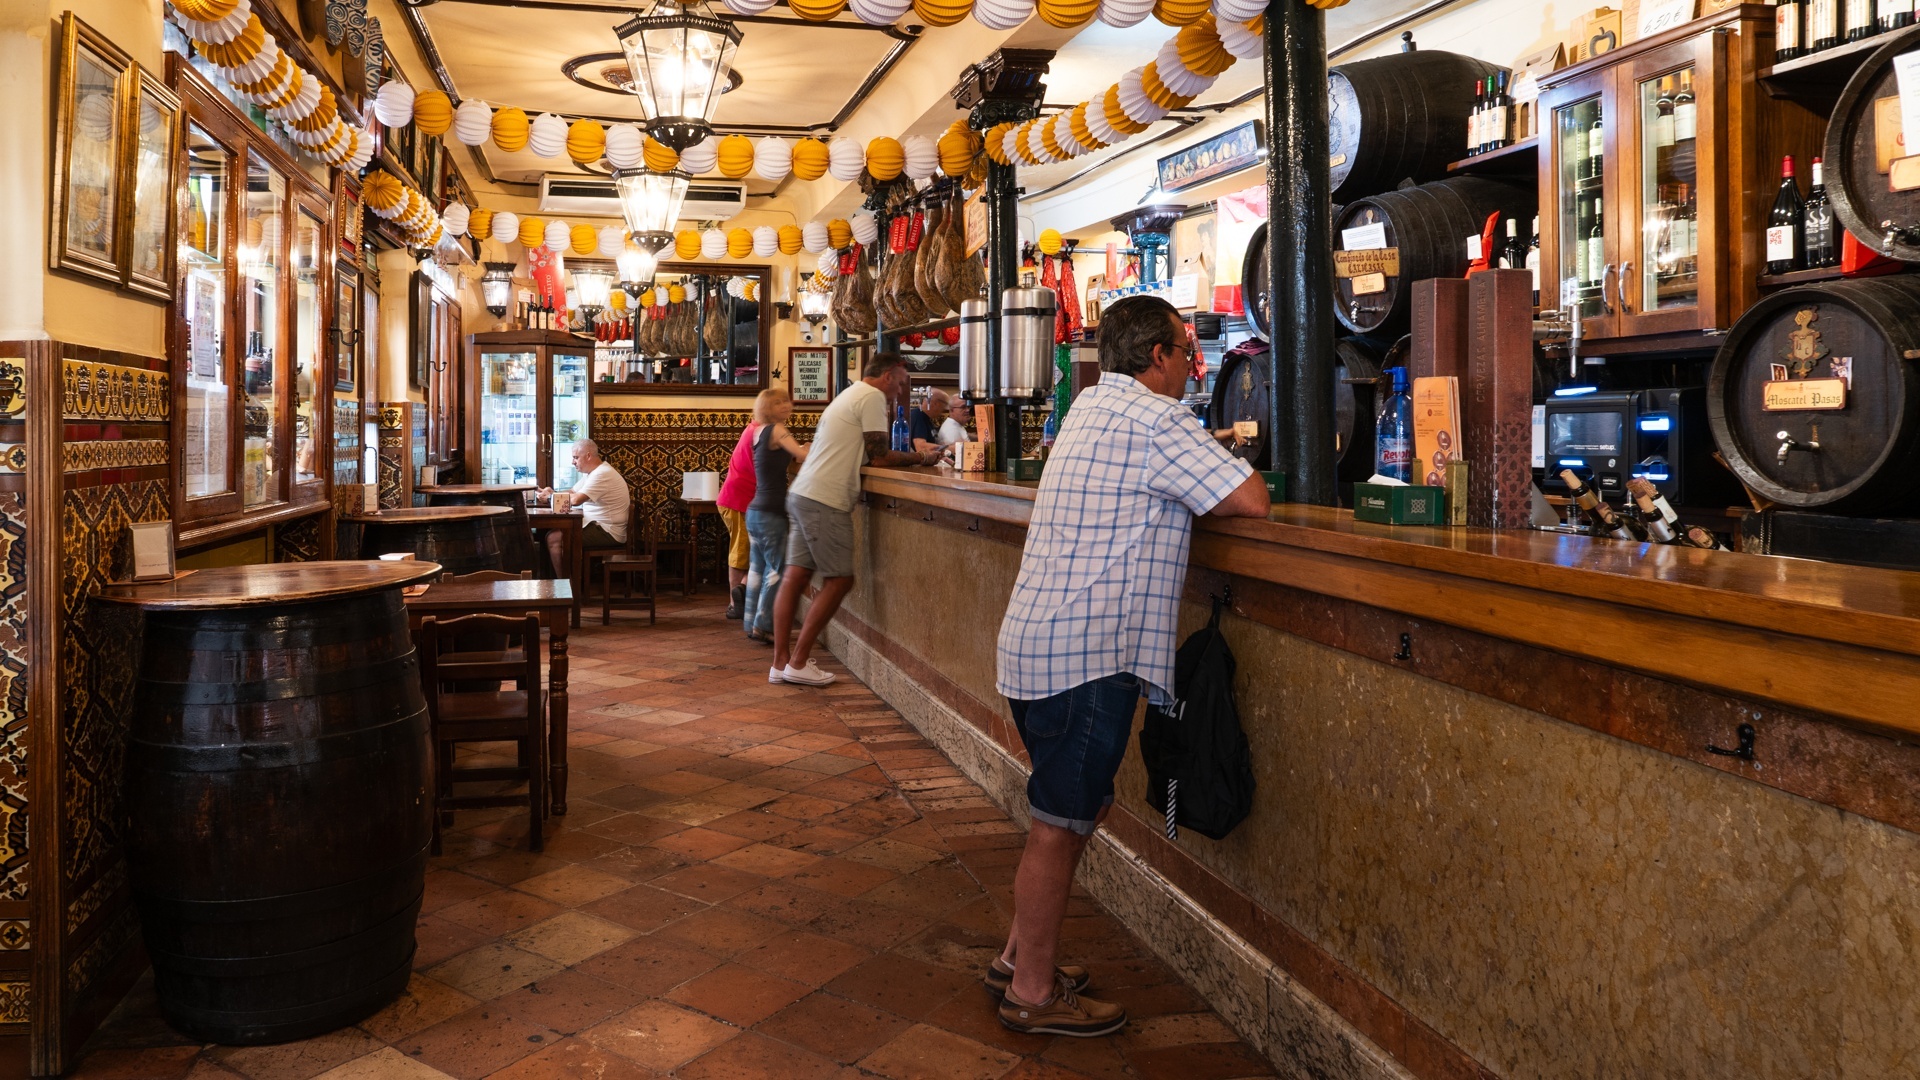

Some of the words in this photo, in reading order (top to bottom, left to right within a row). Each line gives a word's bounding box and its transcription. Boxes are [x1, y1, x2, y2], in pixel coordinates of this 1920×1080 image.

[898, 223, 906, 247] JOSELITO
[911, 219, 921, 244] JOSELITO
[1365, 252, 1372, 261] de
[1372, 250, 1379, 260] la
[1476, 281, 1487, 341] ALHAMBRA
[1475, 347, 1486, 403] CERVEZAS
[1766, 394, 1807, 407] Moscatel
[1811, 392, 1841, 406] Pasas
